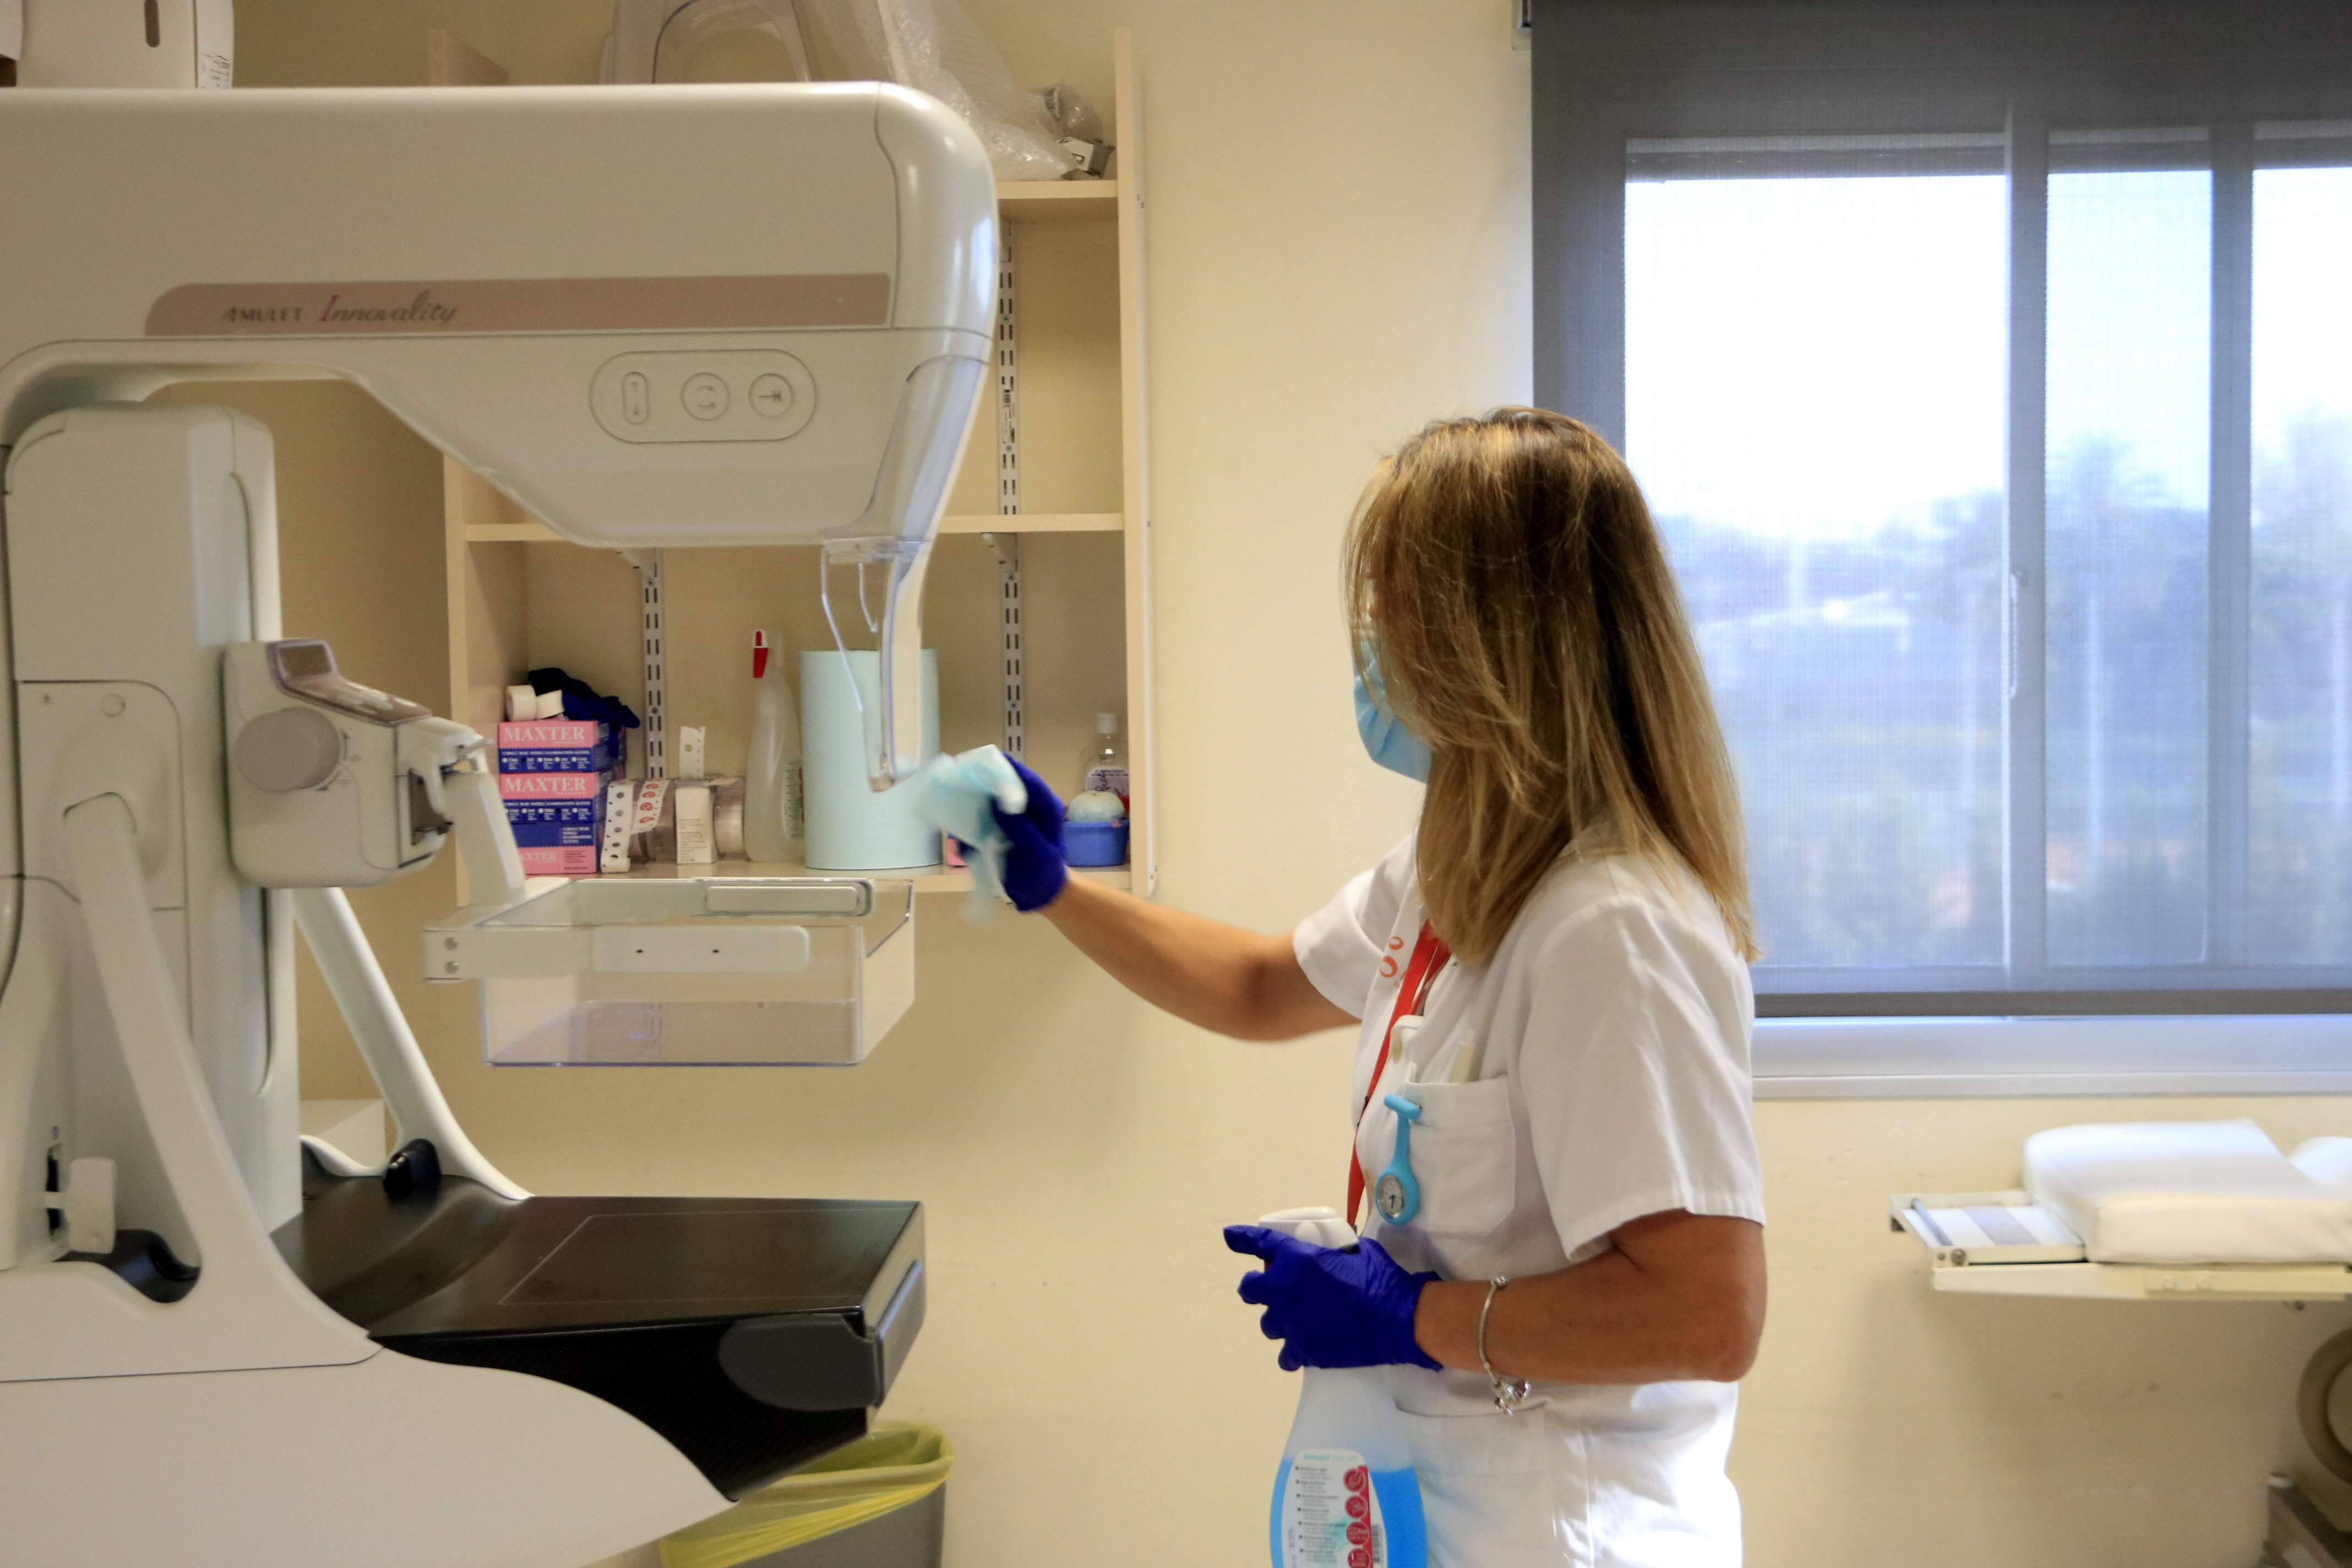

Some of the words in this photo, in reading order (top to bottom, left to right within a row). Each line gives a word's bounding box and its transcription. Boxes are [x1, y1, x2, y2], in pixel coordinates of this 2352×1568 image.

[319, 290, 457, 325] Innovality
[503, 726, 586, 741] MAXTER
[504, 777, 586, 792] MAXTER
